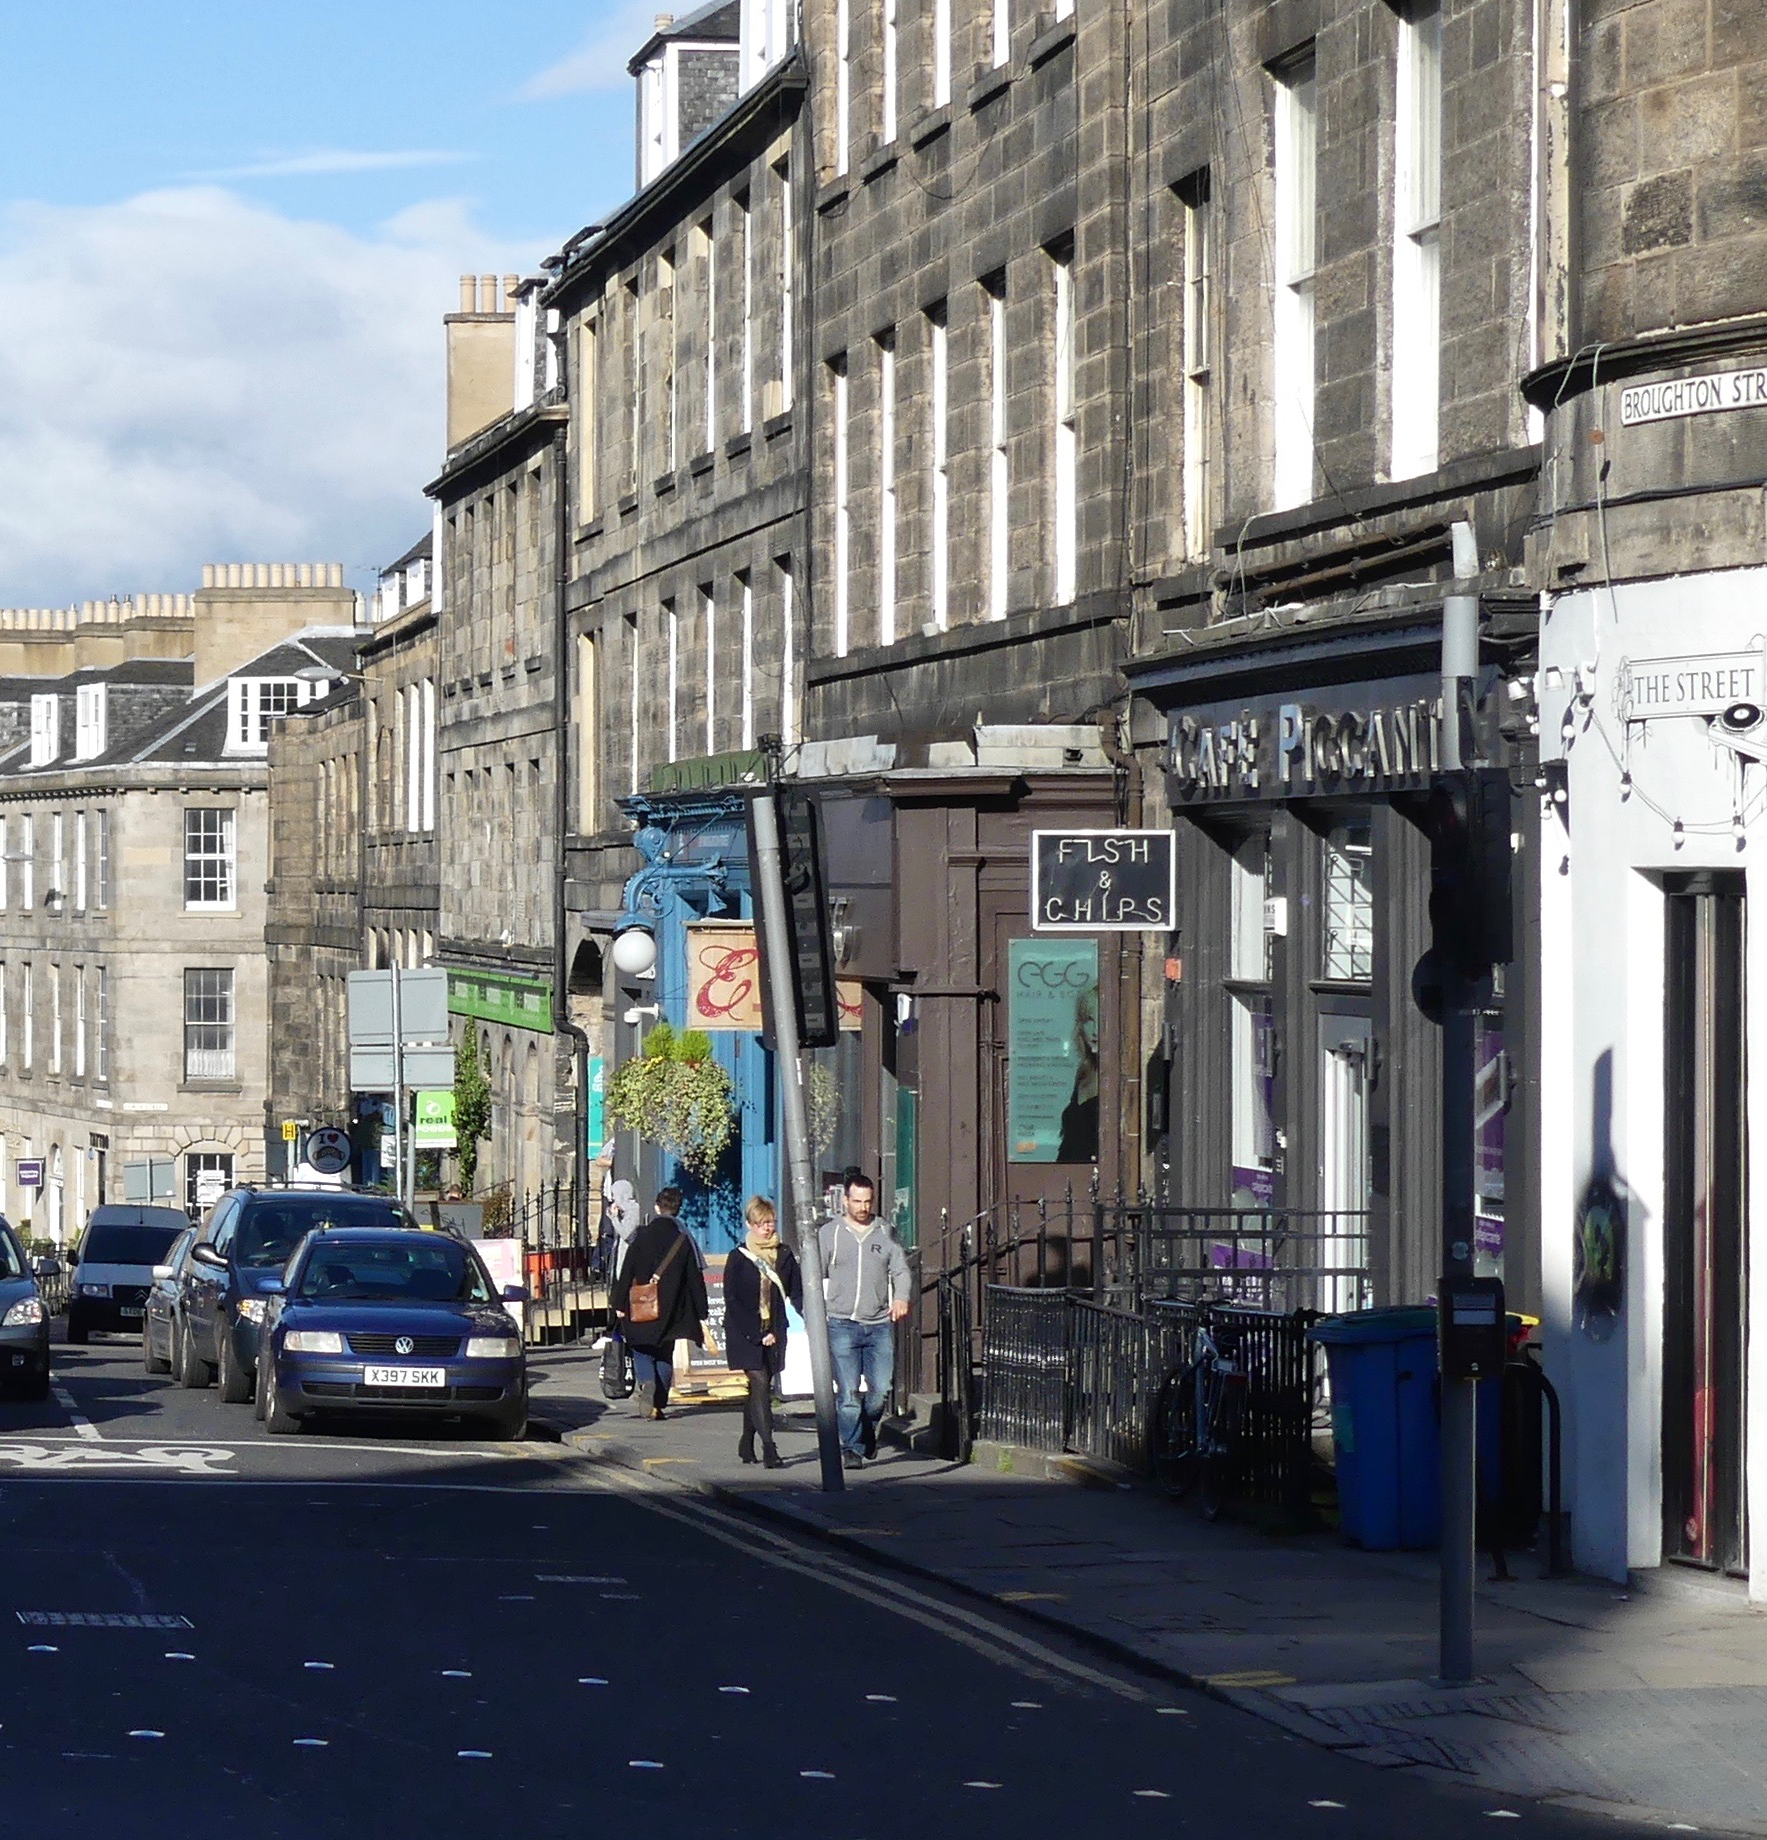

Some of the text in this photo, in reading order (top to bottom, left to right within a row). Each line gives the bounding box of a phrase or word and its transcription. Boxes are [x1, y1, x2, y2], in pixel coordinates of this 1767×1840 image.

[1624, 377, 1722, 420] BROUGHTON
[1634, 668, 1755, 705] THE STREET
[1279, 697, 1444, 782] PICCANT
[1058, 838, 1148, 863] FISH
[1099, 870, 1112, 889] &
[1045, 897, 1162, 923] CHIPS
[419, 1115, 448, 1125] real
[371, 1369, 439, 1384] X397 SKK
